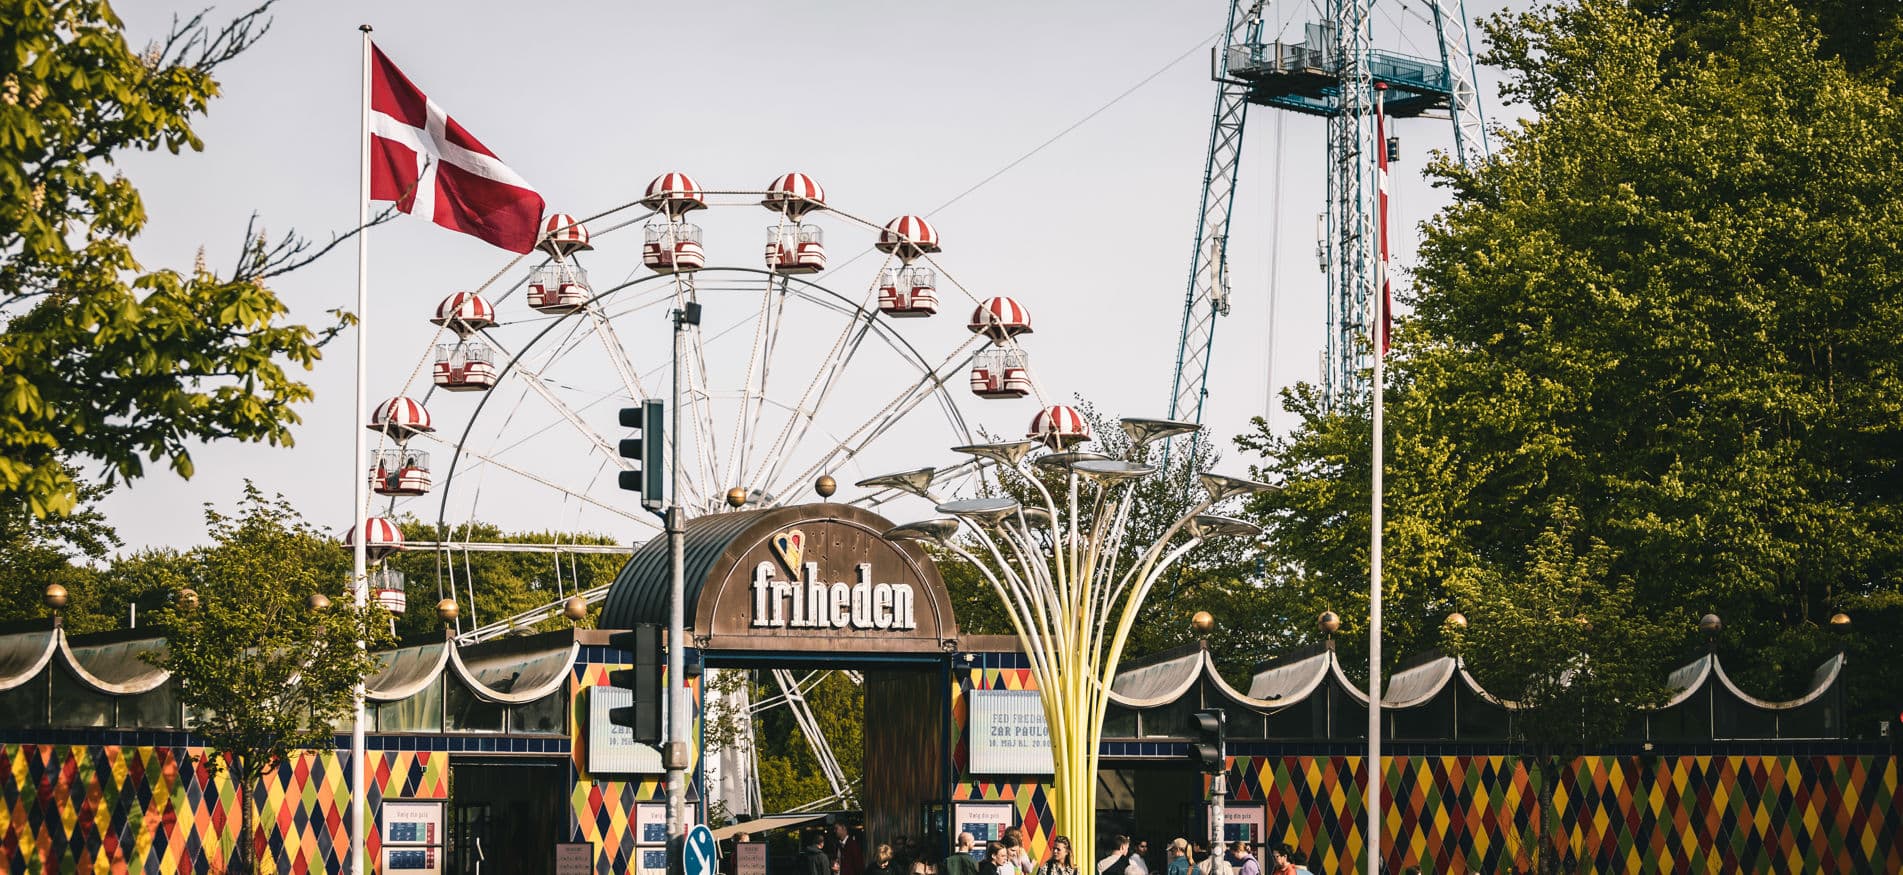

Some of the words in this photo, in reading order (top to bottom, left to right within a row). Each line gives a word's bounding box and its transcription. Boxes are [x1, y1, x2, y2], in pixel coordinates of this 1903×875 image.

[753, 561, 917, 629] friheden
[992, 713, 1009, 723] FED
[991, 726, 1011, 736] ZAR
[1015, 726, 1049, 736] PAULO
[1001, 739, 1017, 747] MAJ
